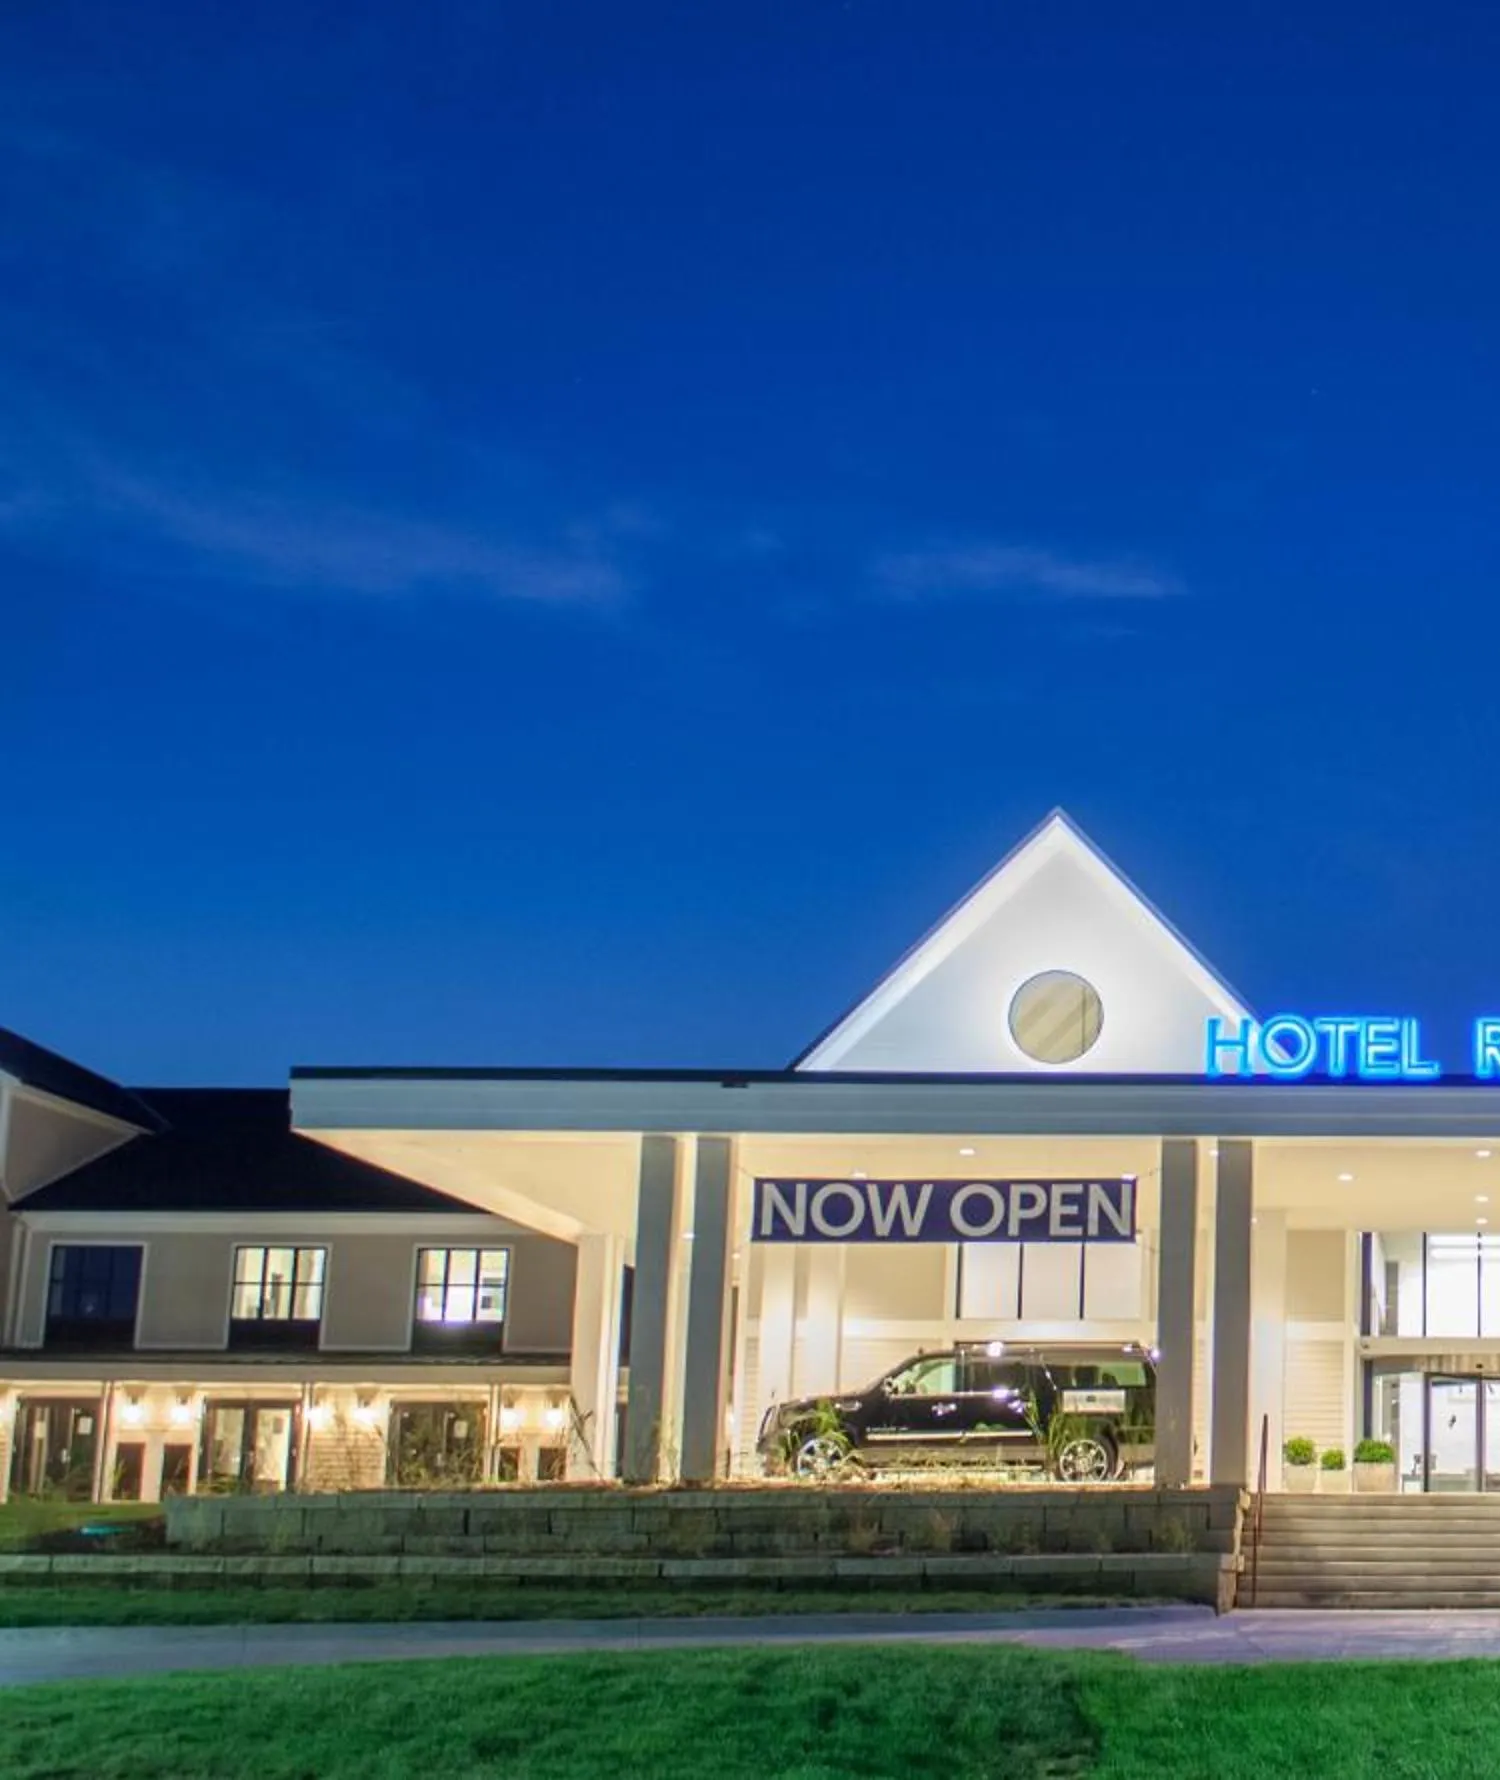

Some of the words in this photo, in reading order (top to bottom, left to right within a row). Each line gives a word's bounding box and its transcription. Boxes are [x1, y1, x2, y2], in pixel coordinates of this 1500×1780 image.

[1205, 1015, 1439, 1078] HOTEL
[760, 1183, 934, 1237] NOW
[949, 1183, 1132, 1237] OPEN
